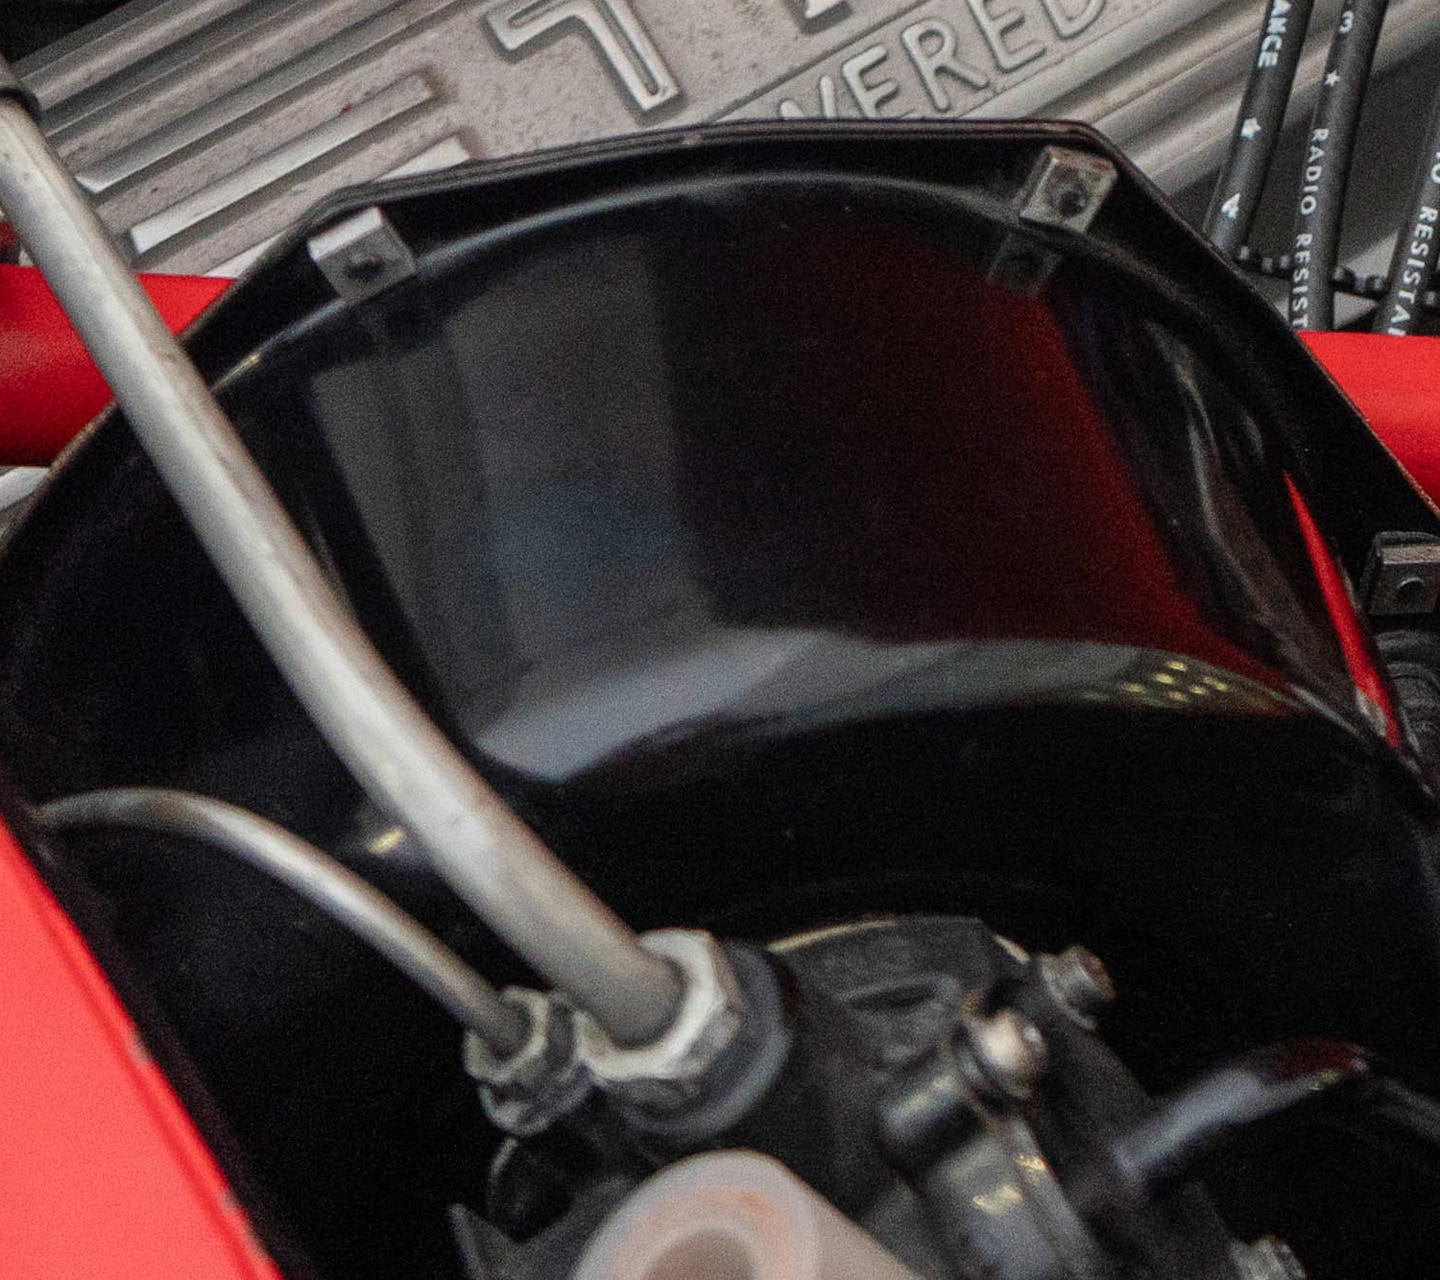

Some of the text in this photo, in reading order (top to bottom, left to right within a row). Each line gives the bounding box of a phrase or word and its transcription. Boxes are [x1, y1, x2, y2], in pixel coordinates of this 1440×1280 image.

[1339, 11, 1355, 35] 3
[1221, 191, 1241, 221] 4
[1298, 126, 1330, 217] RADIO
[1290, 232, 1314, 332] RESIST
[1388, 205, 1440, 337] RESISTA
